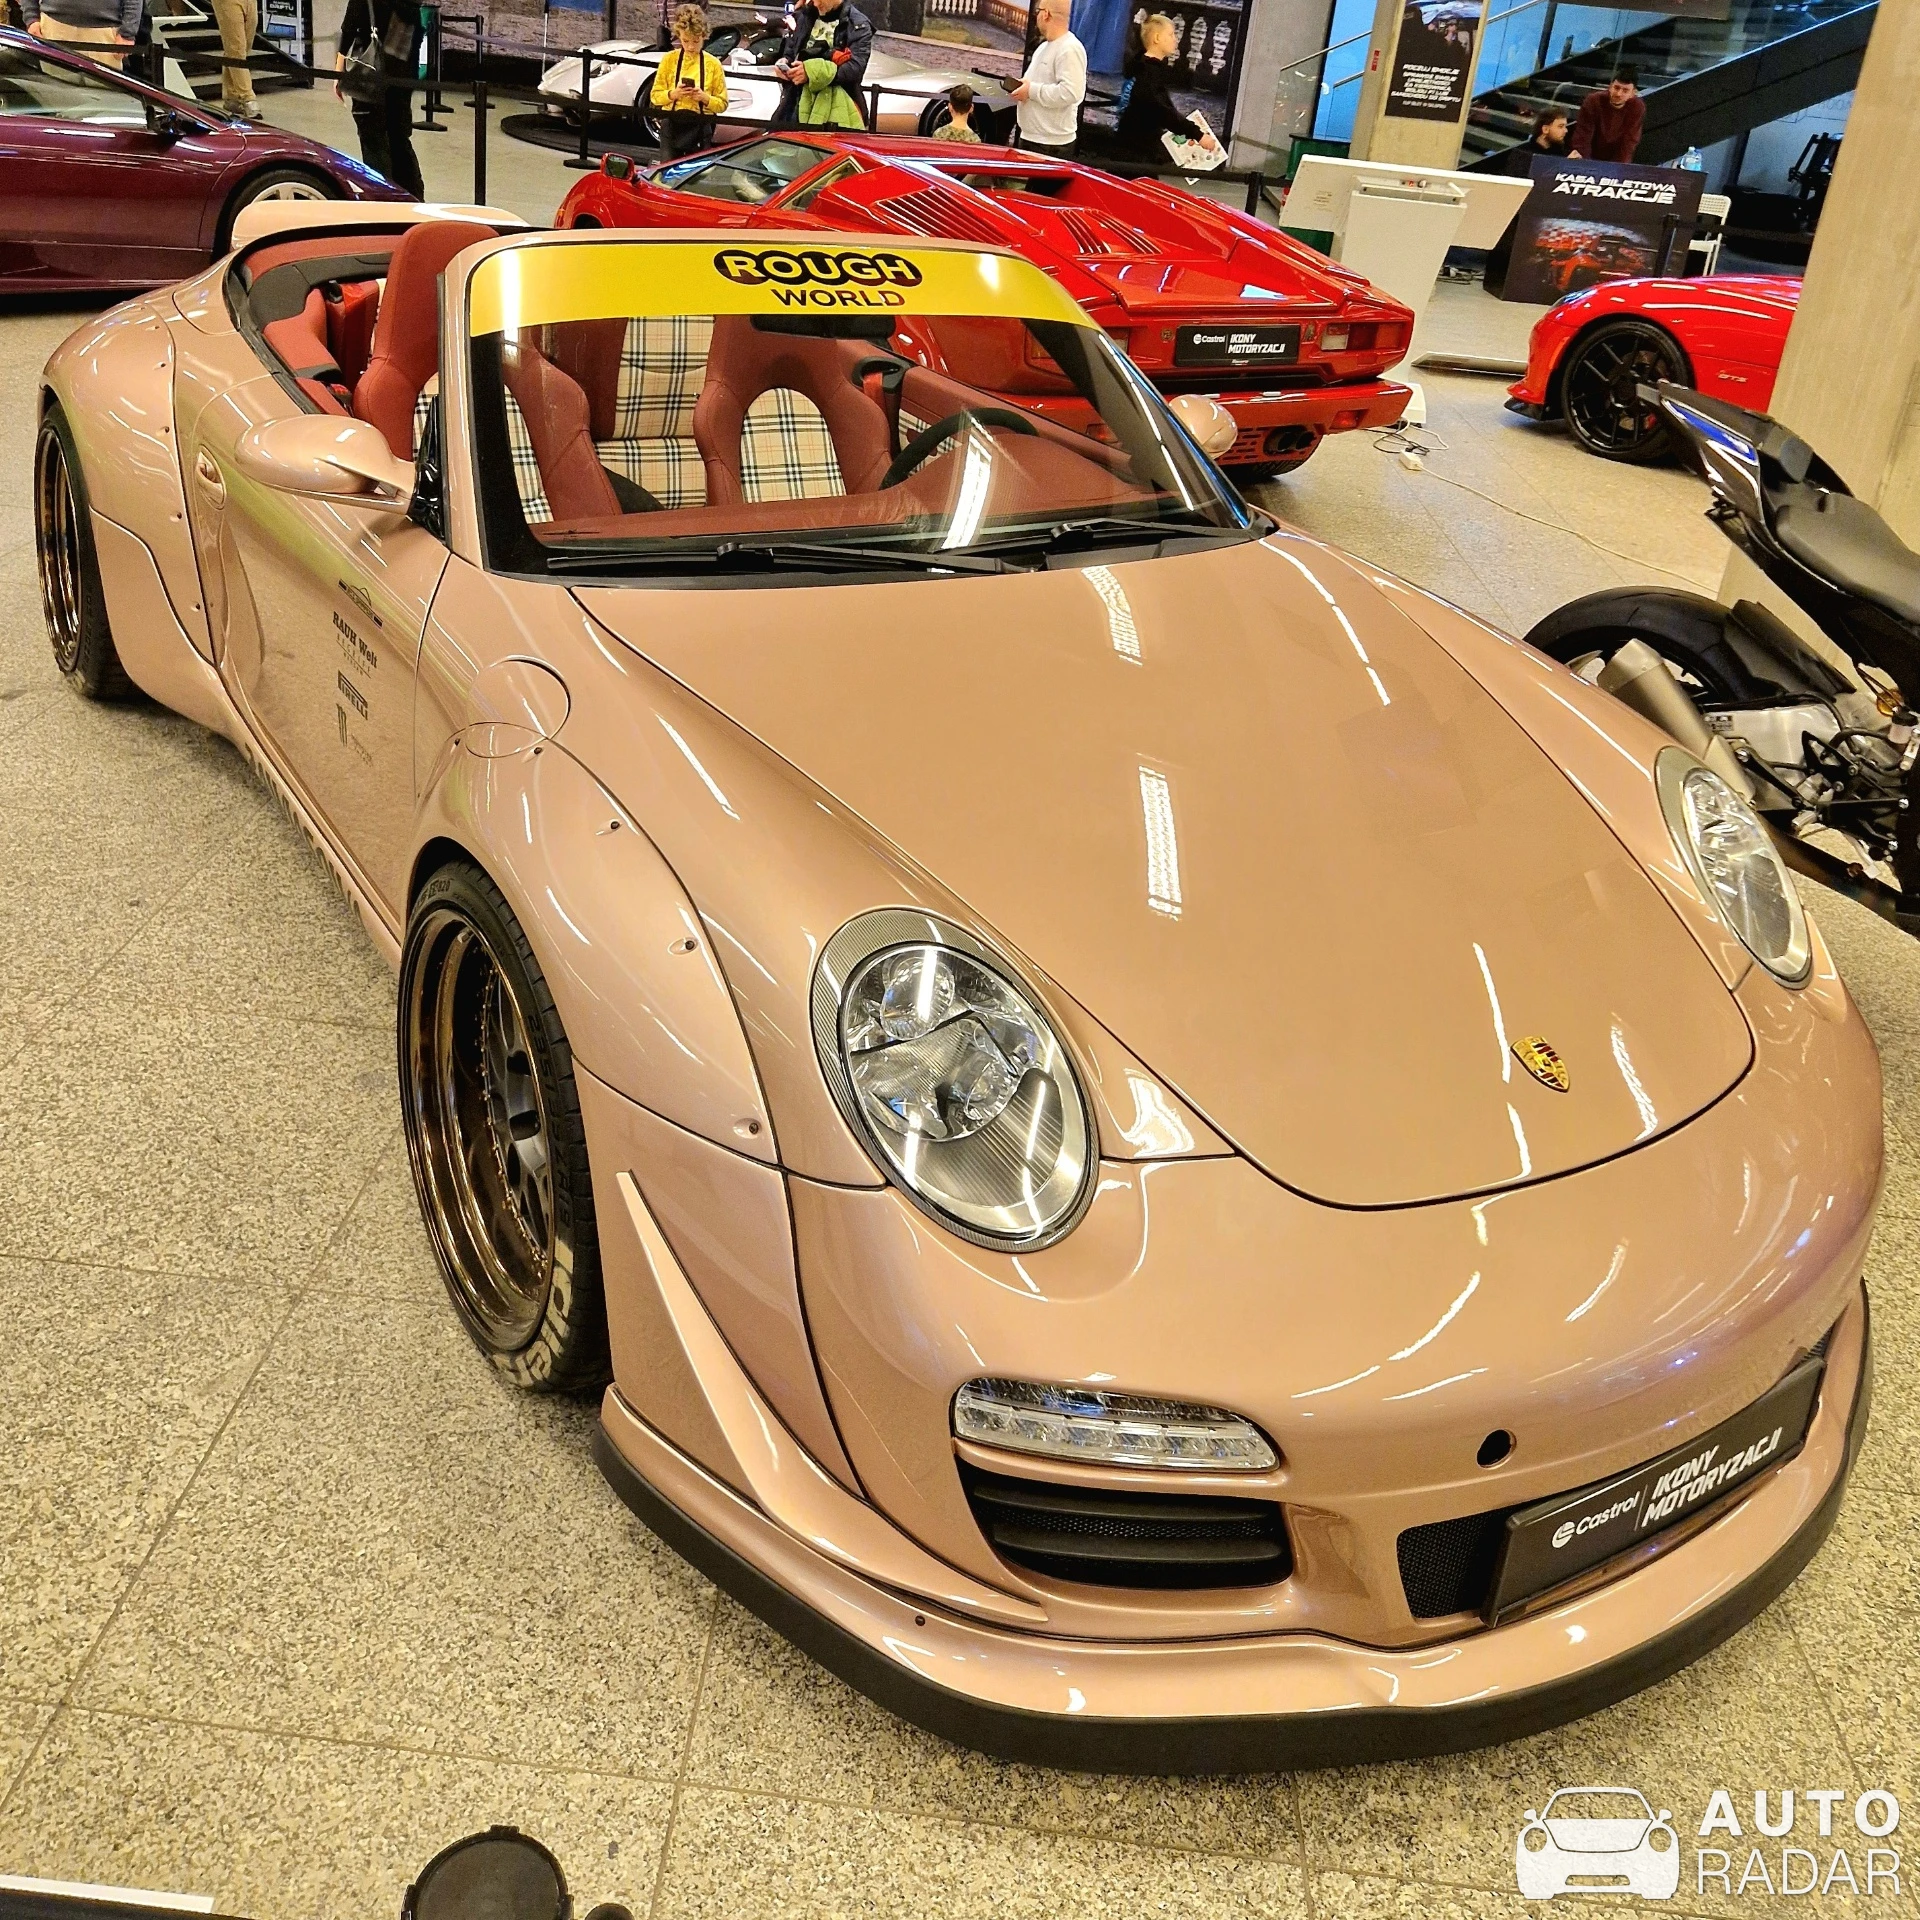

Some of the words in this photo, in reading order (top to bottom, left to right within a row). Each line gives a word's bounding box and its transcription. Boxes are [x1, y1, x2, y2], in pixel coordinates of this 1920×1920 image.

[1552, 182, 1677, 205] ATRAKCJE
[1555, 173, 1595, 184] KASA
[1599, 177, 1677, 193] BILETOWA
[719, 253, 918, 283] ROUGH
[770, 288, 906, 307] WORLD
[1201, 334, 1226, 343] Castrol
[1227, 343, 1286, 354] MOTORYZACJI
[1230, 333, 1257, 343] IKONY
[332, 610, 357, 647] RAUH
[358, 637, 378, 669] Welt
[337, 669, 368, 721] PIRELLI
[1641, 1426, 1784, 1528] MOTORYZACJI
[1650, 1444, 1720, 1501] IKONY
[1575, 1490, 1641, 1536] Castrol
